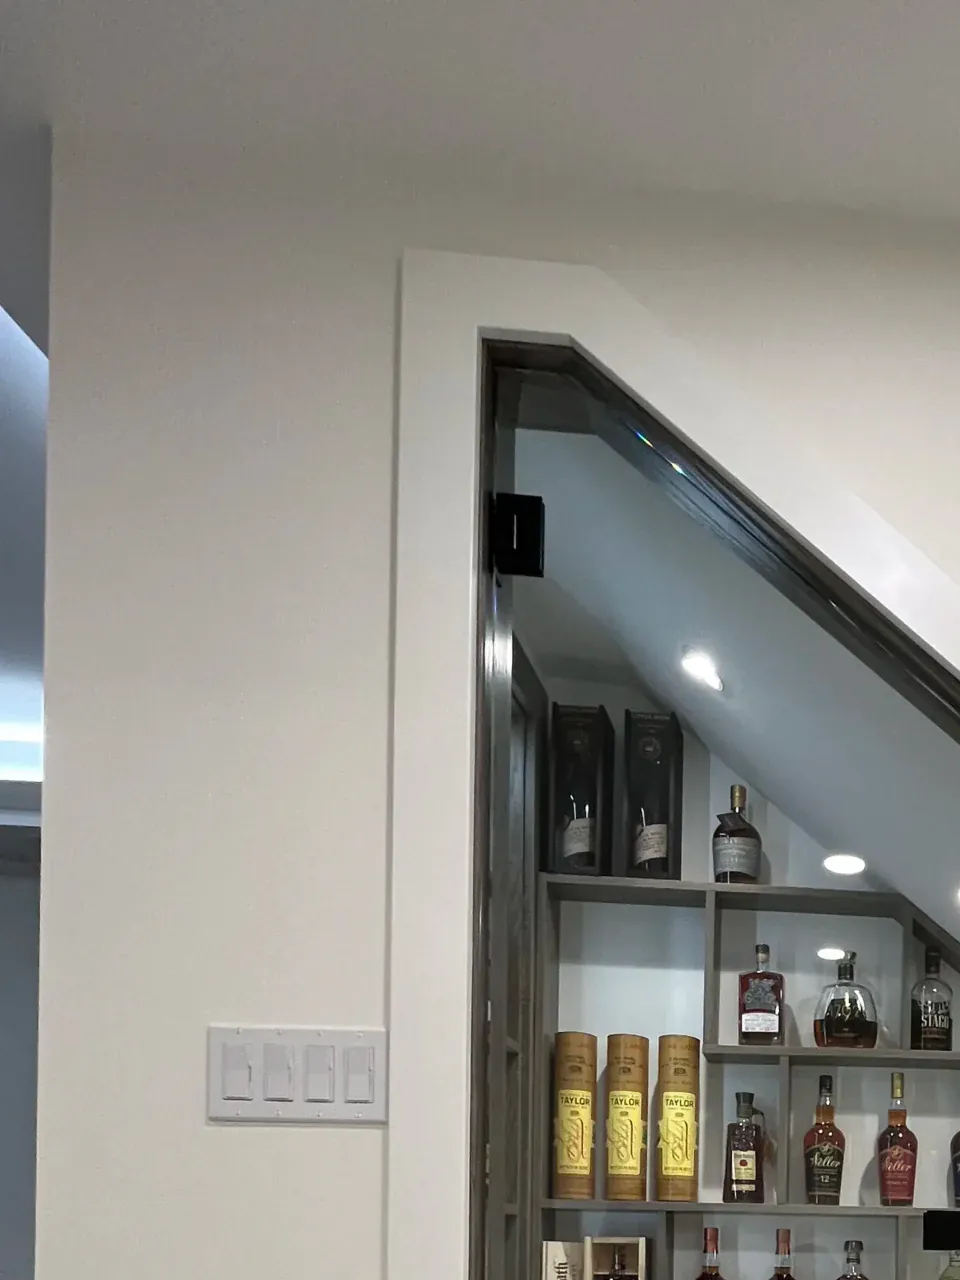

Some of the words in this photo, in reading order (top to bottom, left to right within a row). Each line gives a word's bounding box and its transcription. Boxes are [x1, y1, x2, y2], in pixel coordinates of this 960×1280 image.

[560, 1096, 590, 1106] TAYLOR
[610, 1097, 640, 1106] TAYLOR
[665, 1098, 694, 1108] TAYLOR
[820, 1175, 830, 1183] 12
